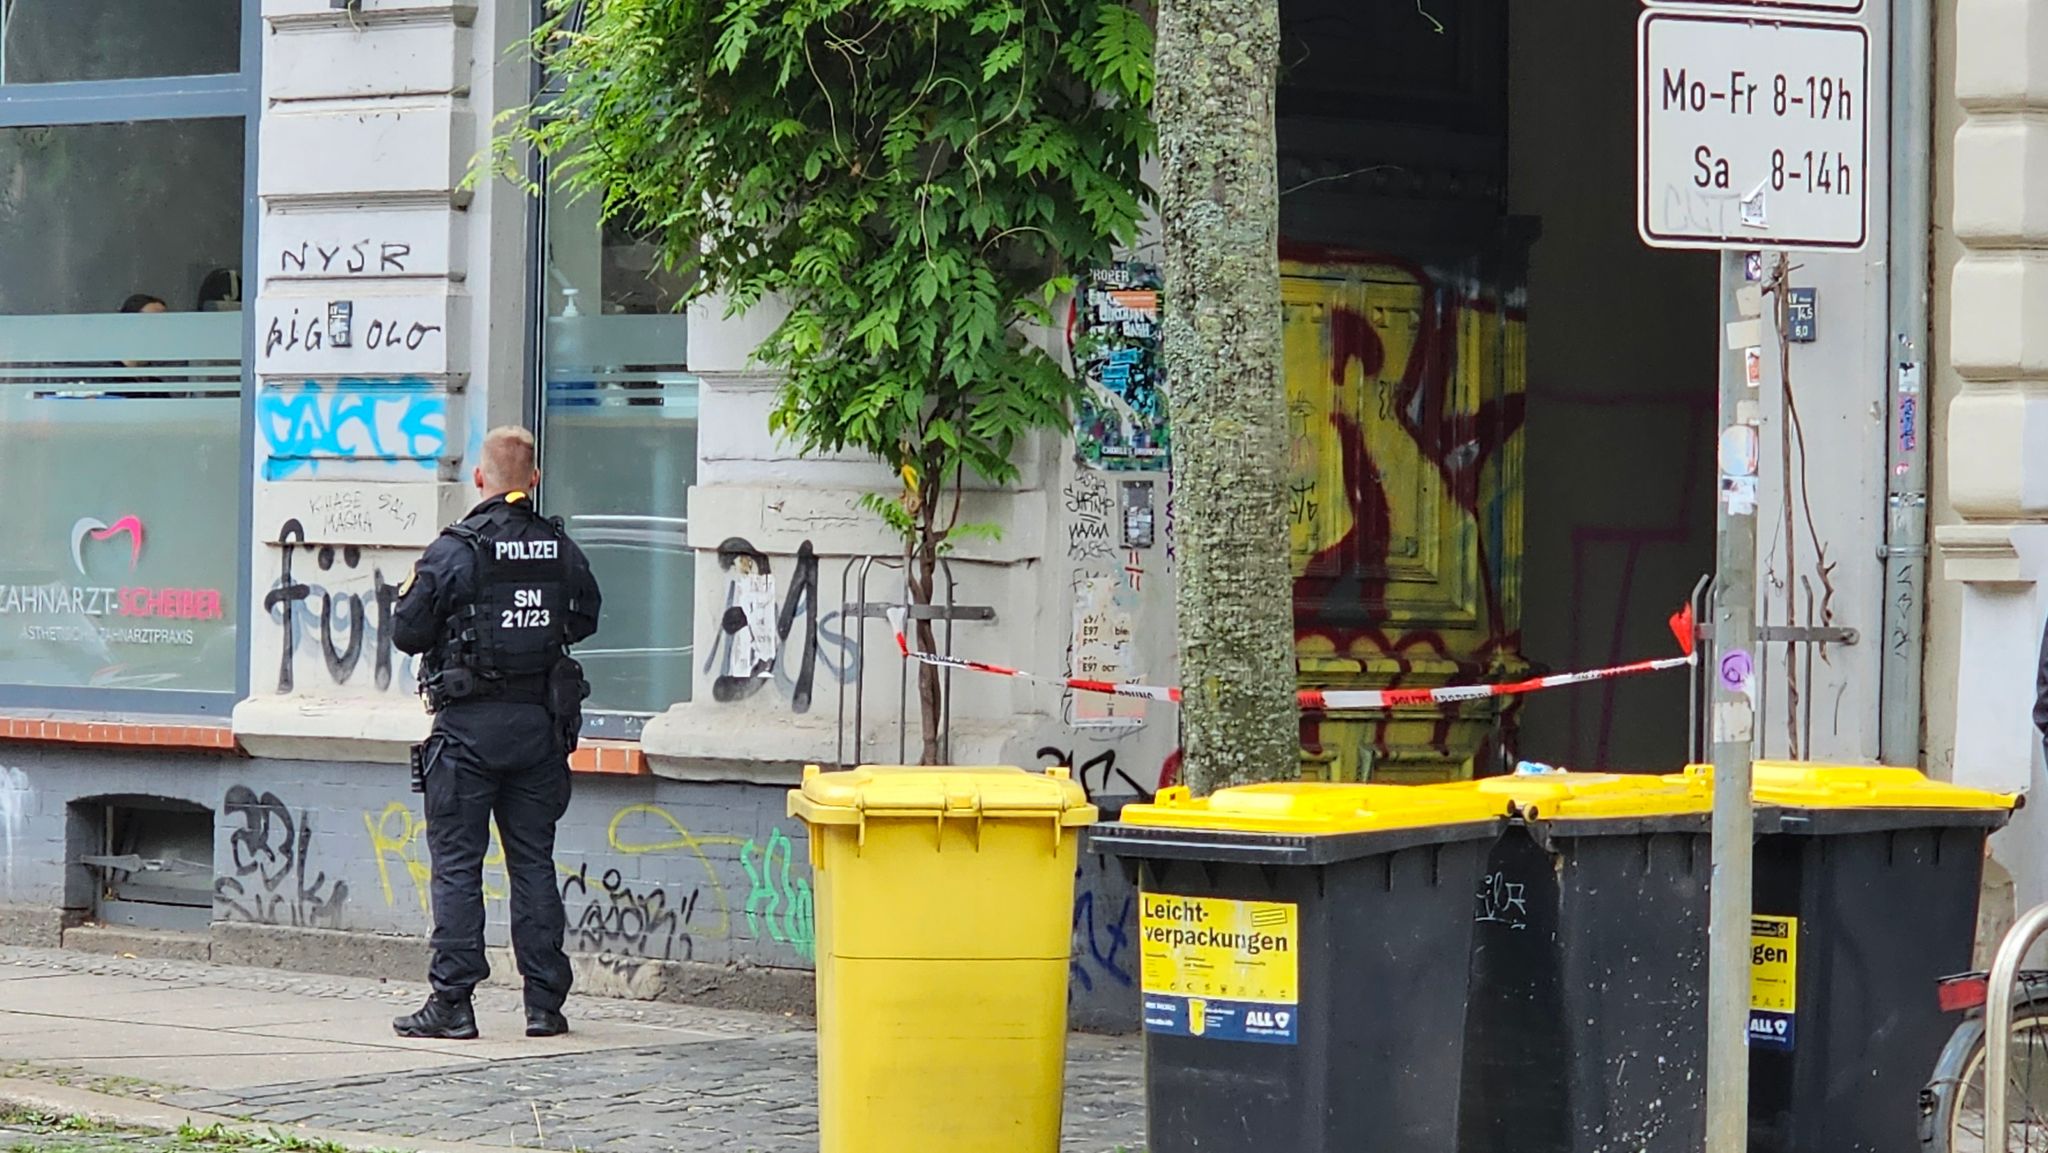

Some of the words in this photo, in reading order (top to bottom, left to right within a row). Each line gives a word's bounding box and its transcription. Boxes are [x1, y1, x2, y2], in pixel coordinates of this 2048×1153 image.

[1662, 67, 1758, 115] Mo-Fr
[1693, 144, 1730, 189] Sa
[495, 540, 559, 560] POLIZEI
[514, 589, 542, 608] SN
[501, 609, 551, 629] 21/23
[1144, 897, 1209, 923] Leicht-
[1144, 926, 1288, 954] verpackungen
[1245, 1011, 1274, 1027] ALL
[1750, 1018, 1773, 1033] ALL
